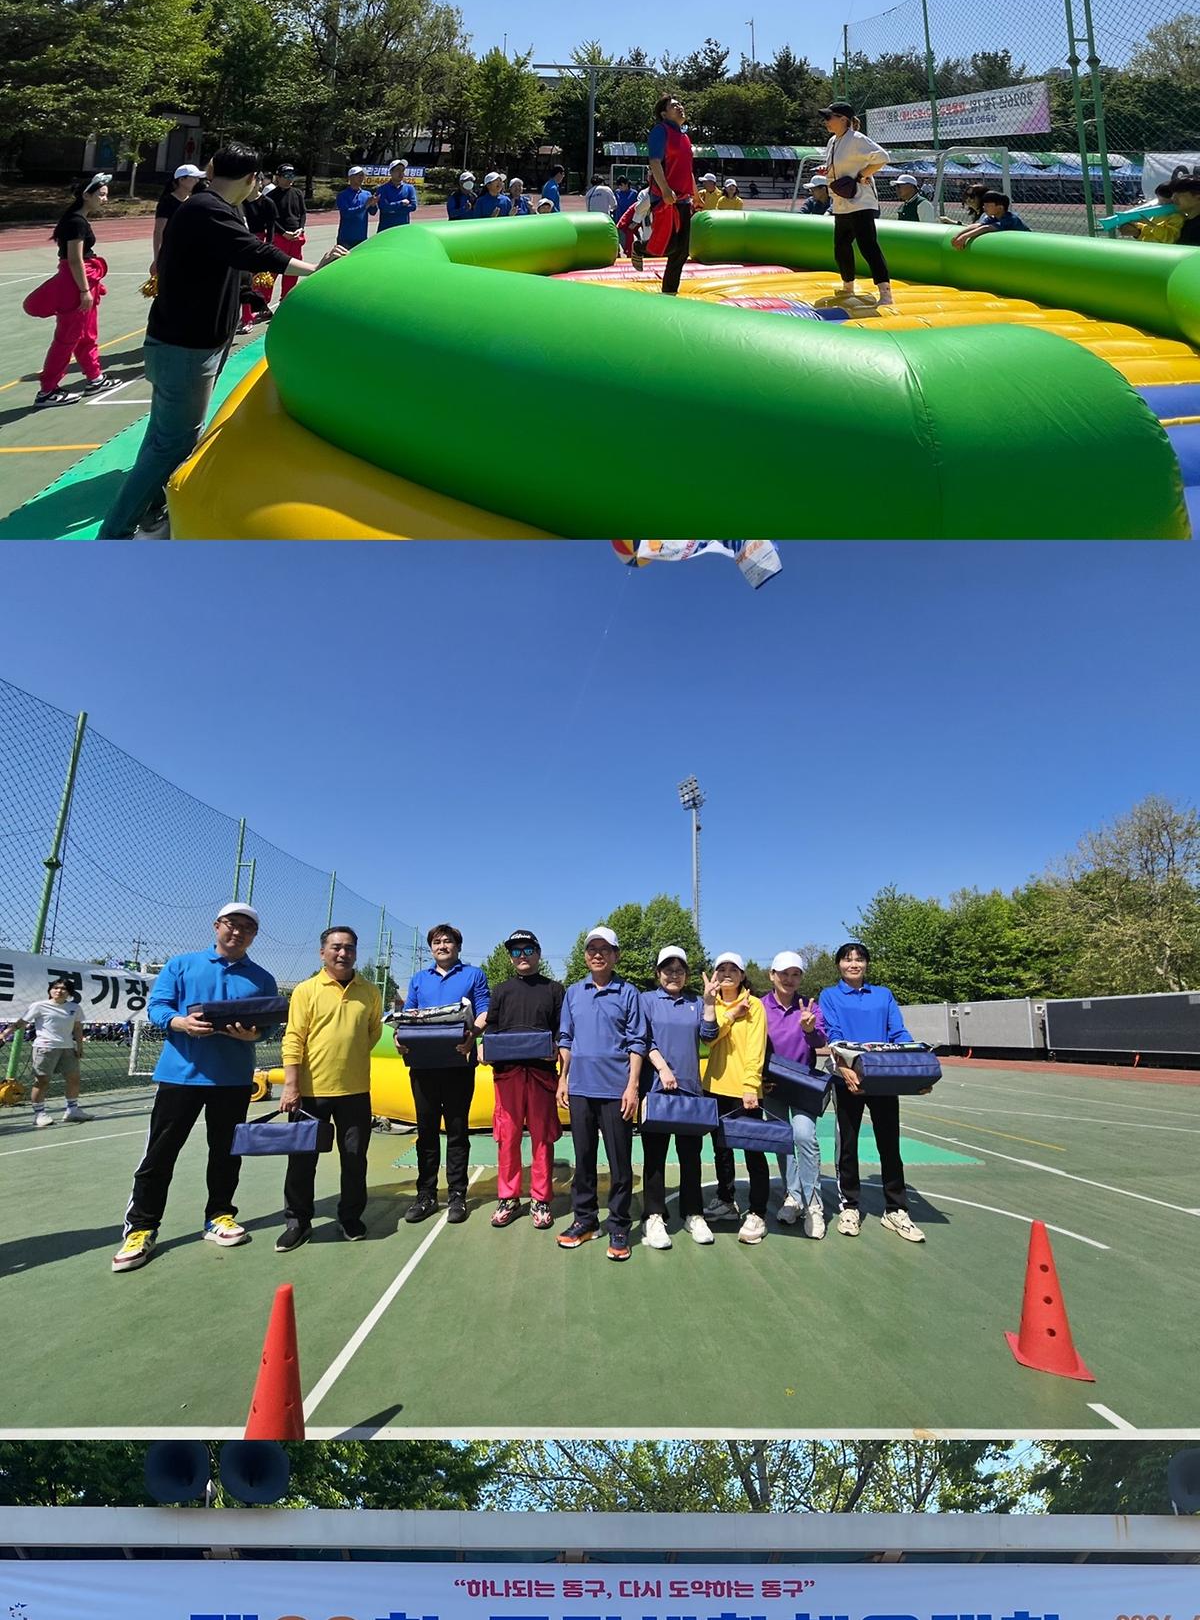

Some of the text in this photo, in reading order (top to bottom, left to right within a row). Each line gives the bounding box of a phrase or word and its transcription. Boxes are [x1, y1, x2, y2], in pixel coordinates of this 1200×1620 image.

[561, 1578, 612, 1600] 동구,
[619, 1579, 661, 1599] 다시
[668, 1578, 755, 1599] 도약하는
